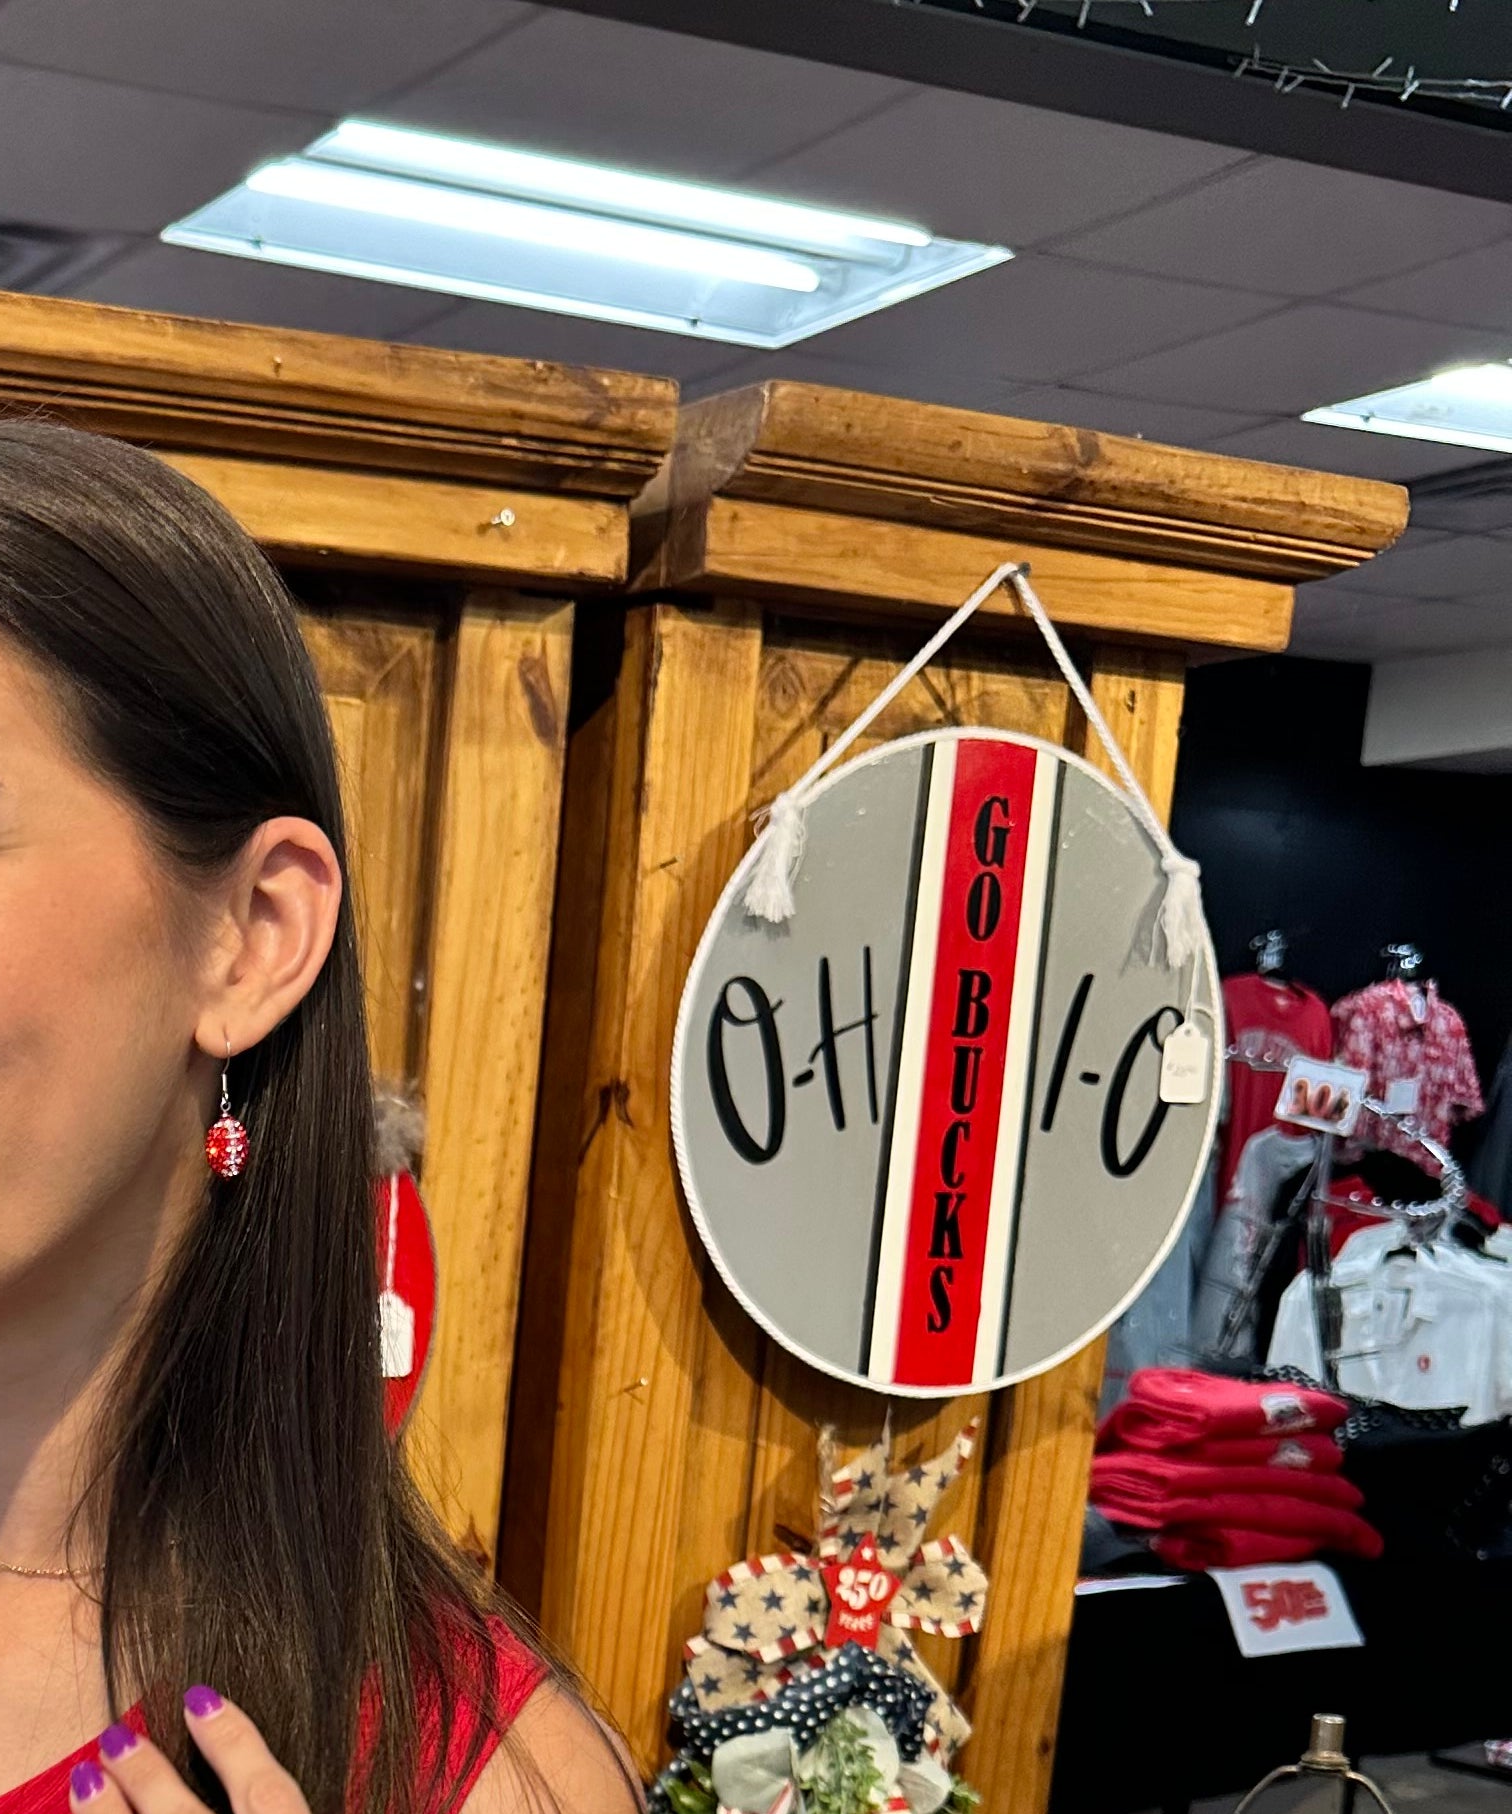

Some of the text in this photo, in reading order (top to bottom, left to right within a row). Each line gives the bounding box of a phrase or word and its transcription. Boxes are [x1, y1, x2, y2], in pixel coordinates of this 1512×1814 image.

[928, 795, 1009, 1334] GO BUCKS
[835, 1566, 889, 1611] 250
